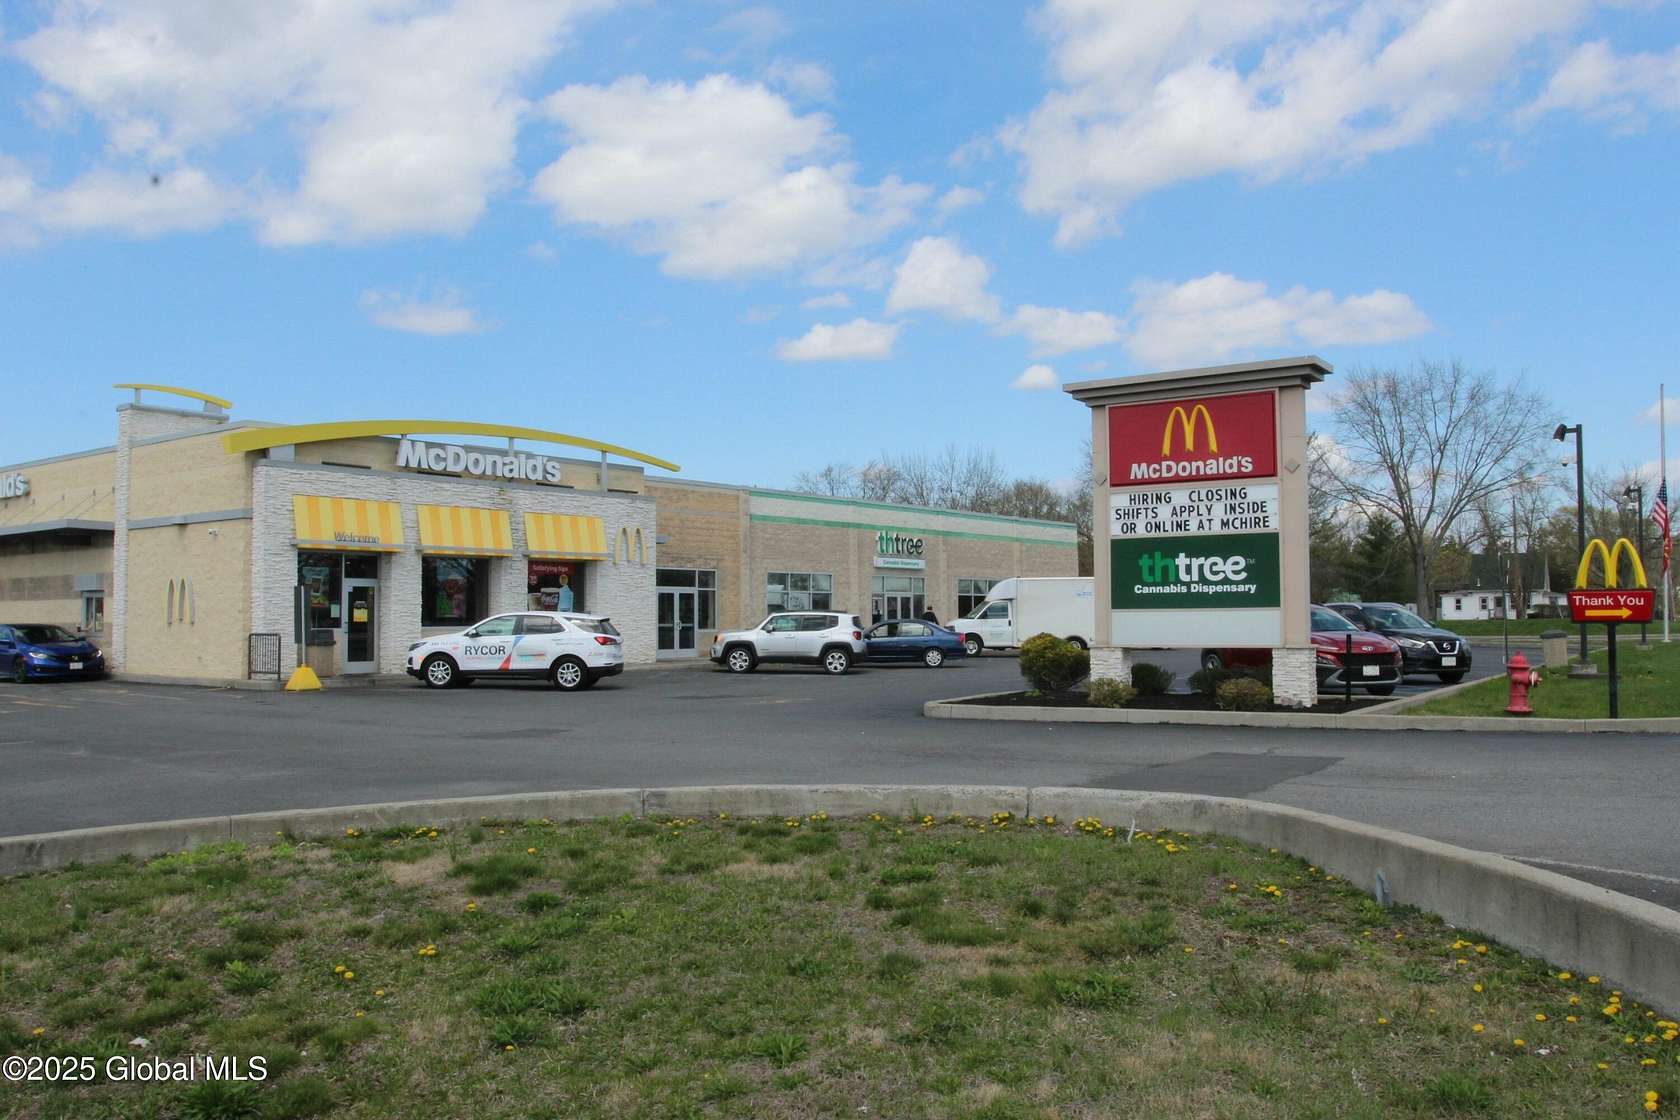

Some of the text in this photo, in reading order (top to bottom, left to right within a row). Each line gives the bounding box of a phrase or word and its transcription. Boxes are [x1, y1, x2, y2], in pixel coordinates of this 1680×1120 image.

[398, 439, 561, 482] McDonald's
[1130, 455, 1254, 480] McDonald's
[1129, 487, 1248, 505] HIRING CLOSING
[1115, 501, 1268, 521] SHIFTS APPLY INSIDE
[1121, 514, 1270, 535] OR ONLINE AT MCHIRE
[334, 531, 380, 545] Welcome
[876, 530, 925, 556] thtree
[1138, 550, 1248, 583] thtree
[1134, 582, 1257, 596] Cannabis Dispensary
[1573, 595, 1645, 606] Thank You
[464, 645, 506, 657] RYCOR
